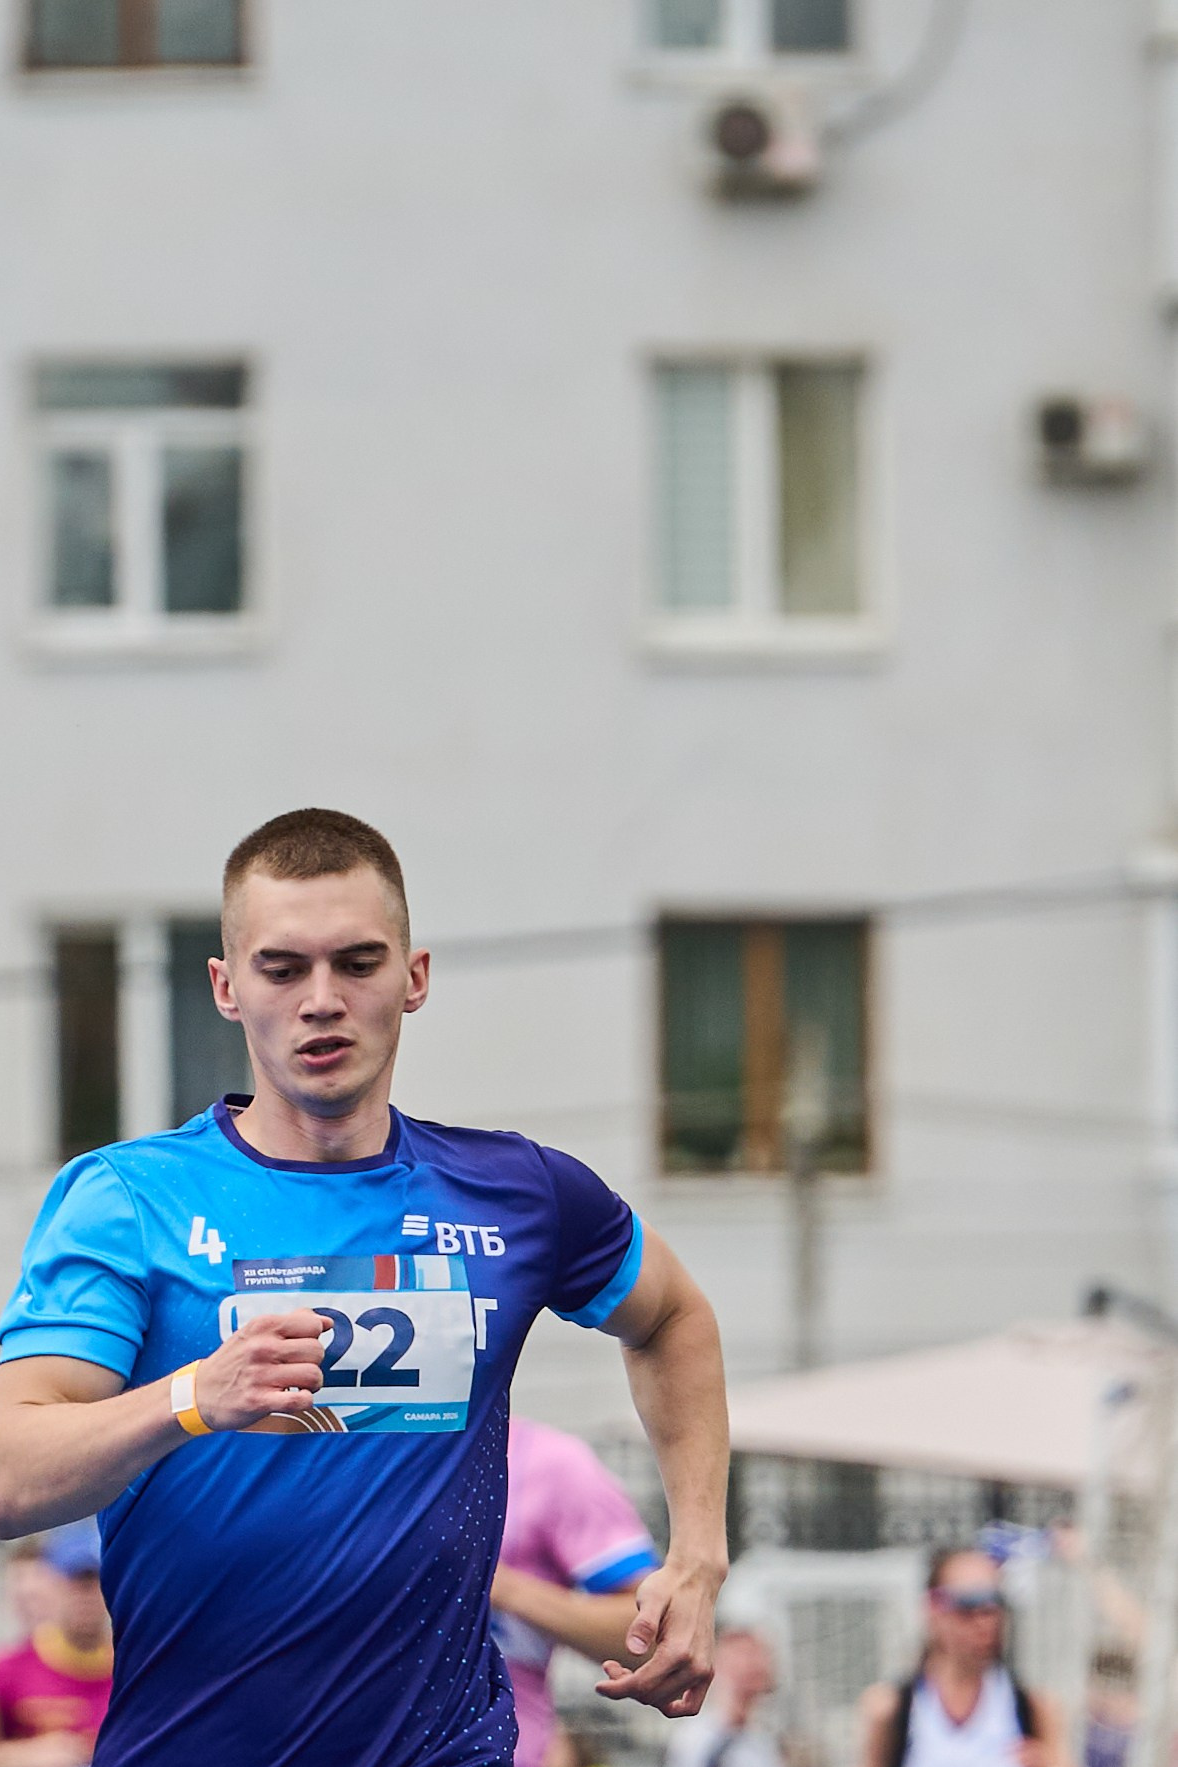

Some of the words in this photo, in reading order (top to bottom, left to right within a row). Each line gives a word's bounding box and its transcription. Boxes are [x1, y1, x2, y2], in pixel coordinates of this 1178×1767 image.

[187, 1216, 227, 1264] 4
[434, 1222, 506, 1257] ВТБ
[245, 1277, 284, 1286] ГРУППЫ
[285, 1276, 304, 1285] ВТБ
[257, 1266, 326, 1276] СПАРТАКИАДА
[313, 1307, 420, 1388] 22
[404, 1412, 441, 1421] САМАРА
